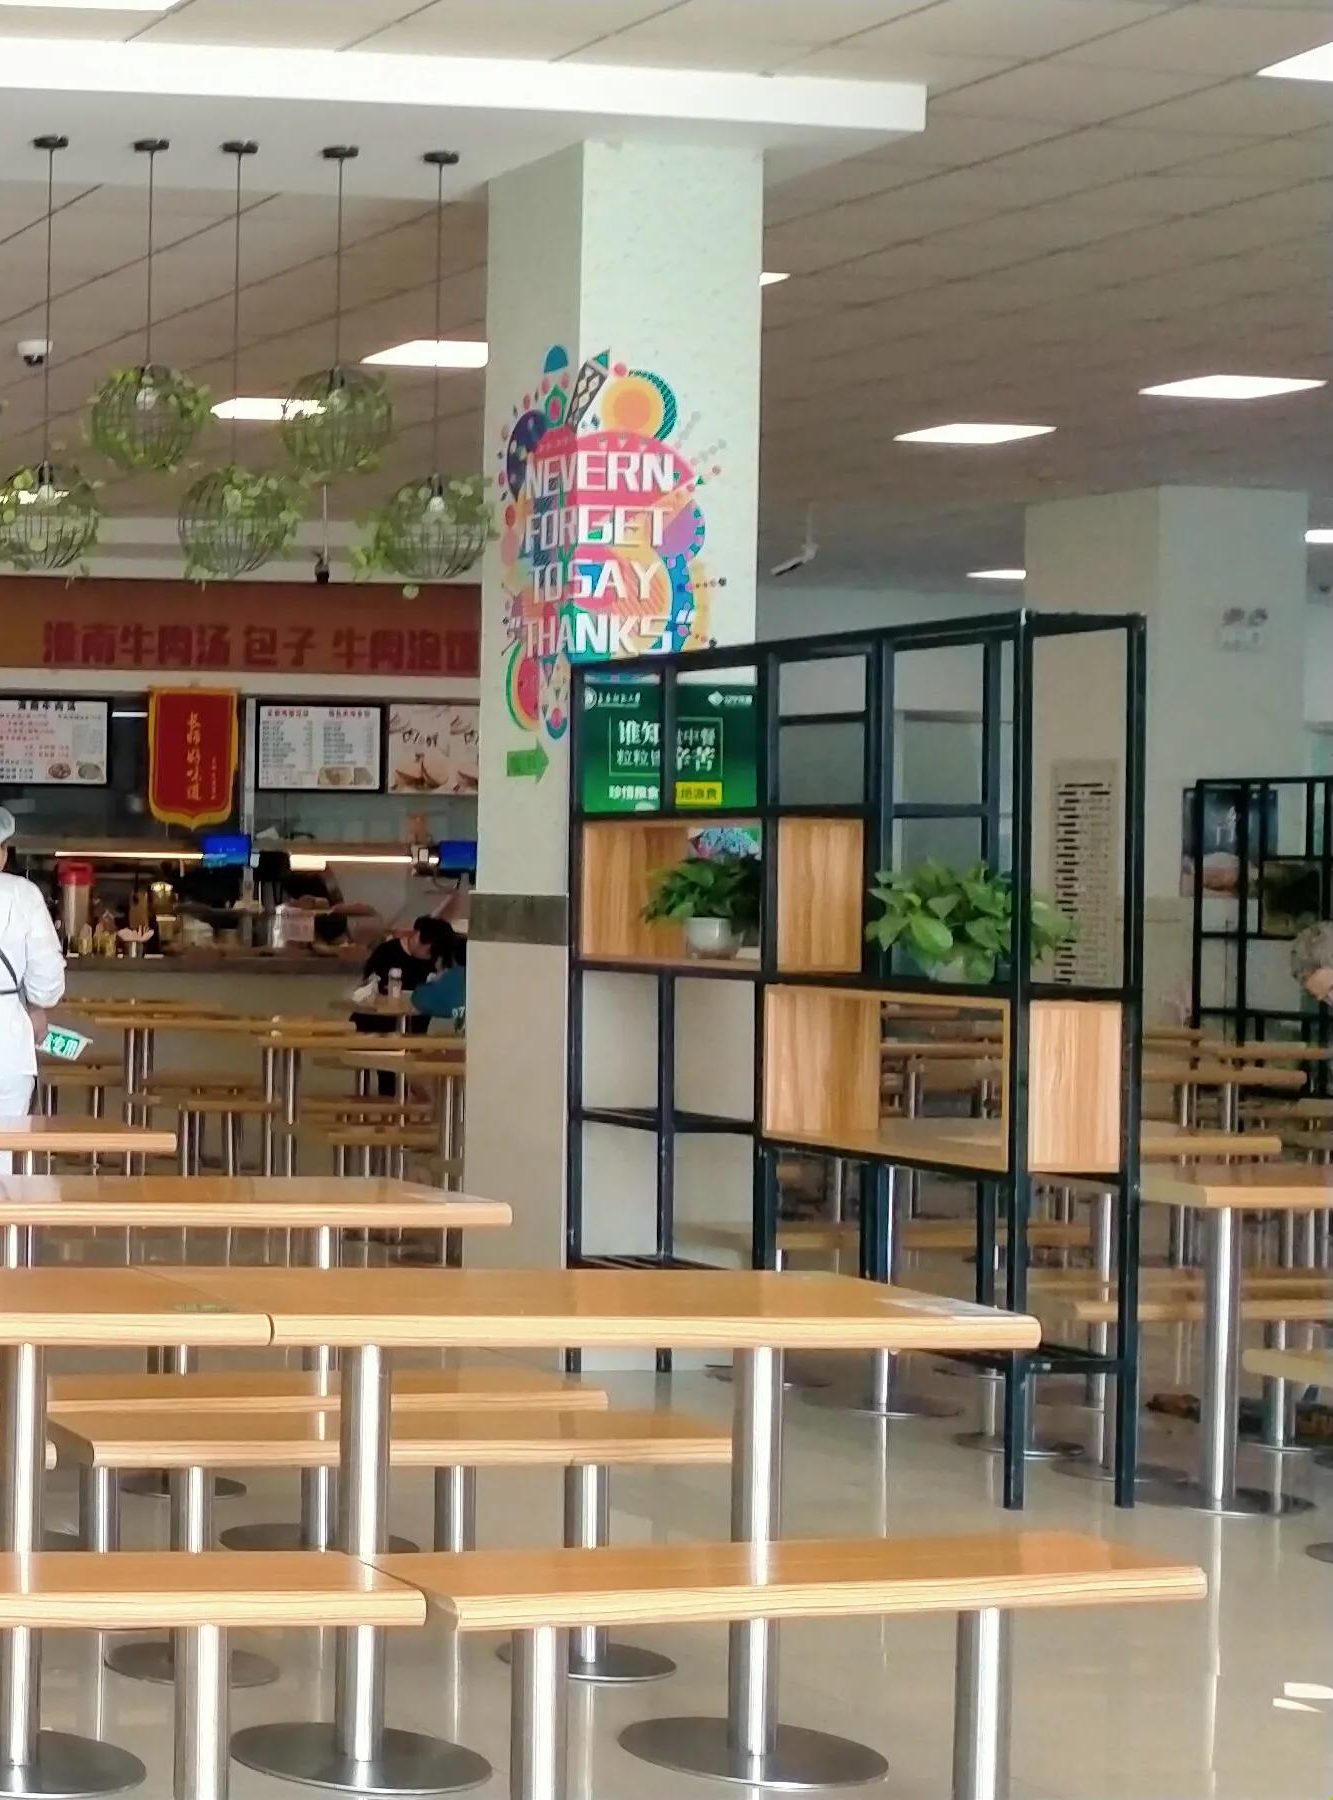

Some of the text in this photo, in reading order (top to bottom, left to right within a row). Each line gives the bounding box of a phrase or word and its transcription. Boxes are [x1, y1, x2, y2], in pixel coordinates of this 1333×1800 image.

[524, 451, 675, 500] NEVERN
[523, 503, 673, 552] FORGET
[244, 624, 317, 667] 包子
